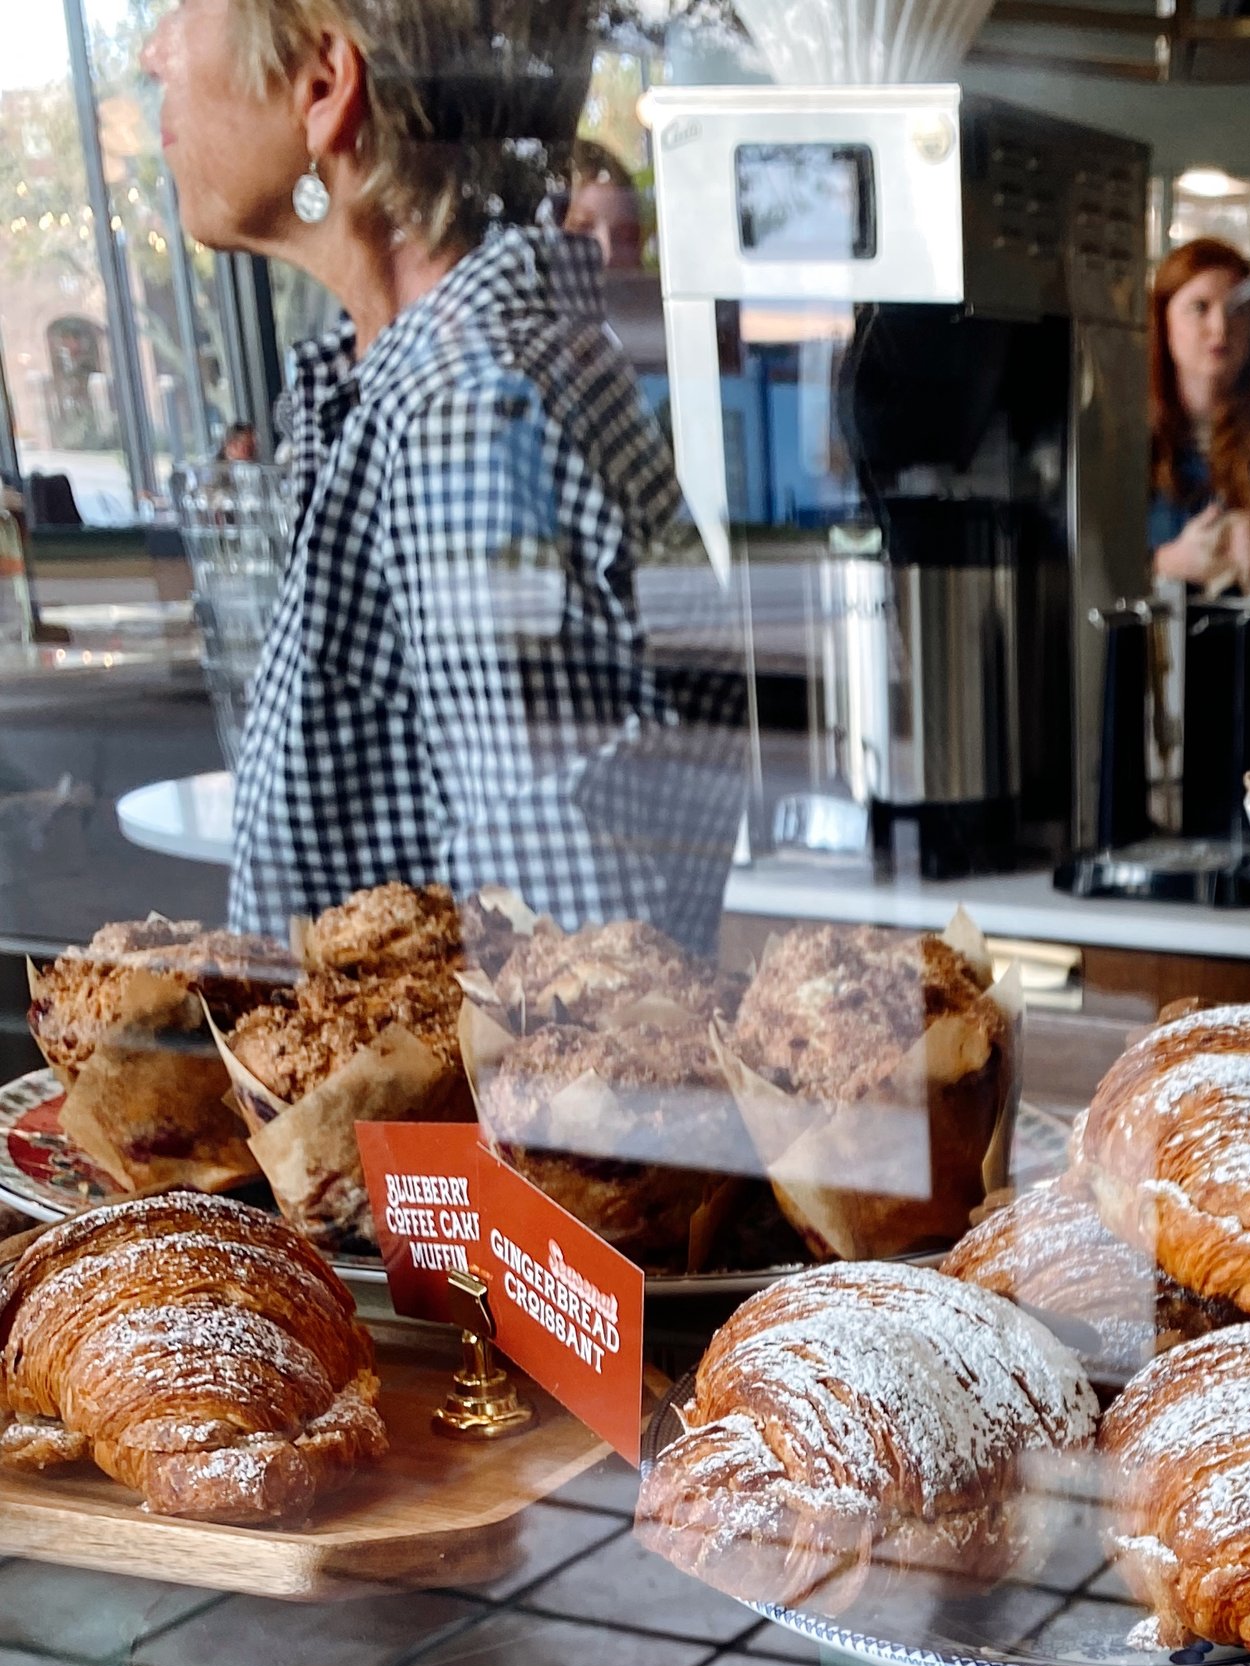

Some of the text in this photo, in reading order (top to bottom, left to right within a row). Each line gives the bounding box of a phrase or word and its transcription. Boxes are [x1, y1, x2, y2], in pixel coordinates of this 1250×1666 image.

[385, 1173, 470, 1208] BLUEBERRY
[385, 1206, 439, 1238] COFFEE
[409, 1240, 469, 1274] MUFFIN
[489, 1228, 620, 1353] GINGERBREAD
[503, 1272, 605, 1375] CROISSANT
